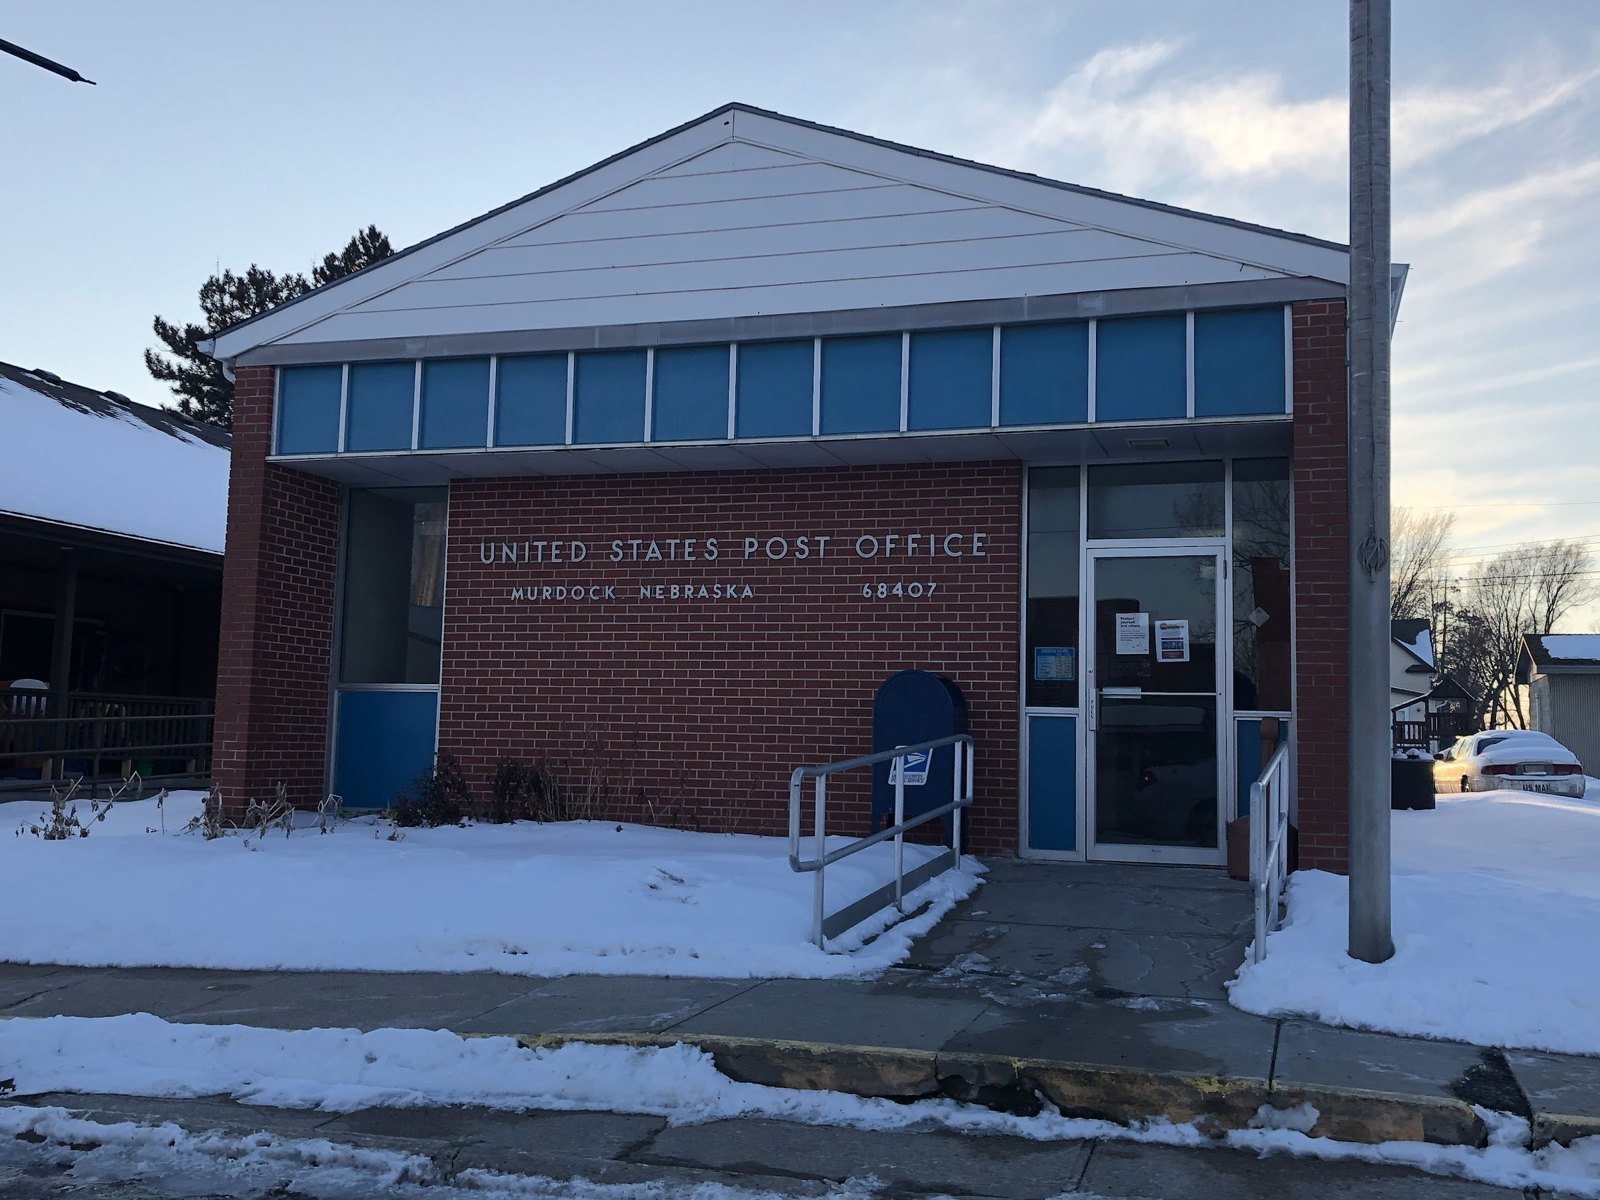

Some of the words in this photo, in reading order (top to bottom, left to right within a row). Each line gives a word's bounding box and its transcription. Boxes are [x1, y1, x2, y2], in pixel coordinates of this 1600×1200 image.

[479, 540, 587, 565] UNITED
[609, 538, 719, 562] STATES
[744, 535, 831, 560] POST
[855, 532, 987, 558] OFFICE
[511, 585, 616, 601] MURDOCK
[640, 583, 754, 600] NEBRASKA
[862, 582, 937, 599] 68407
